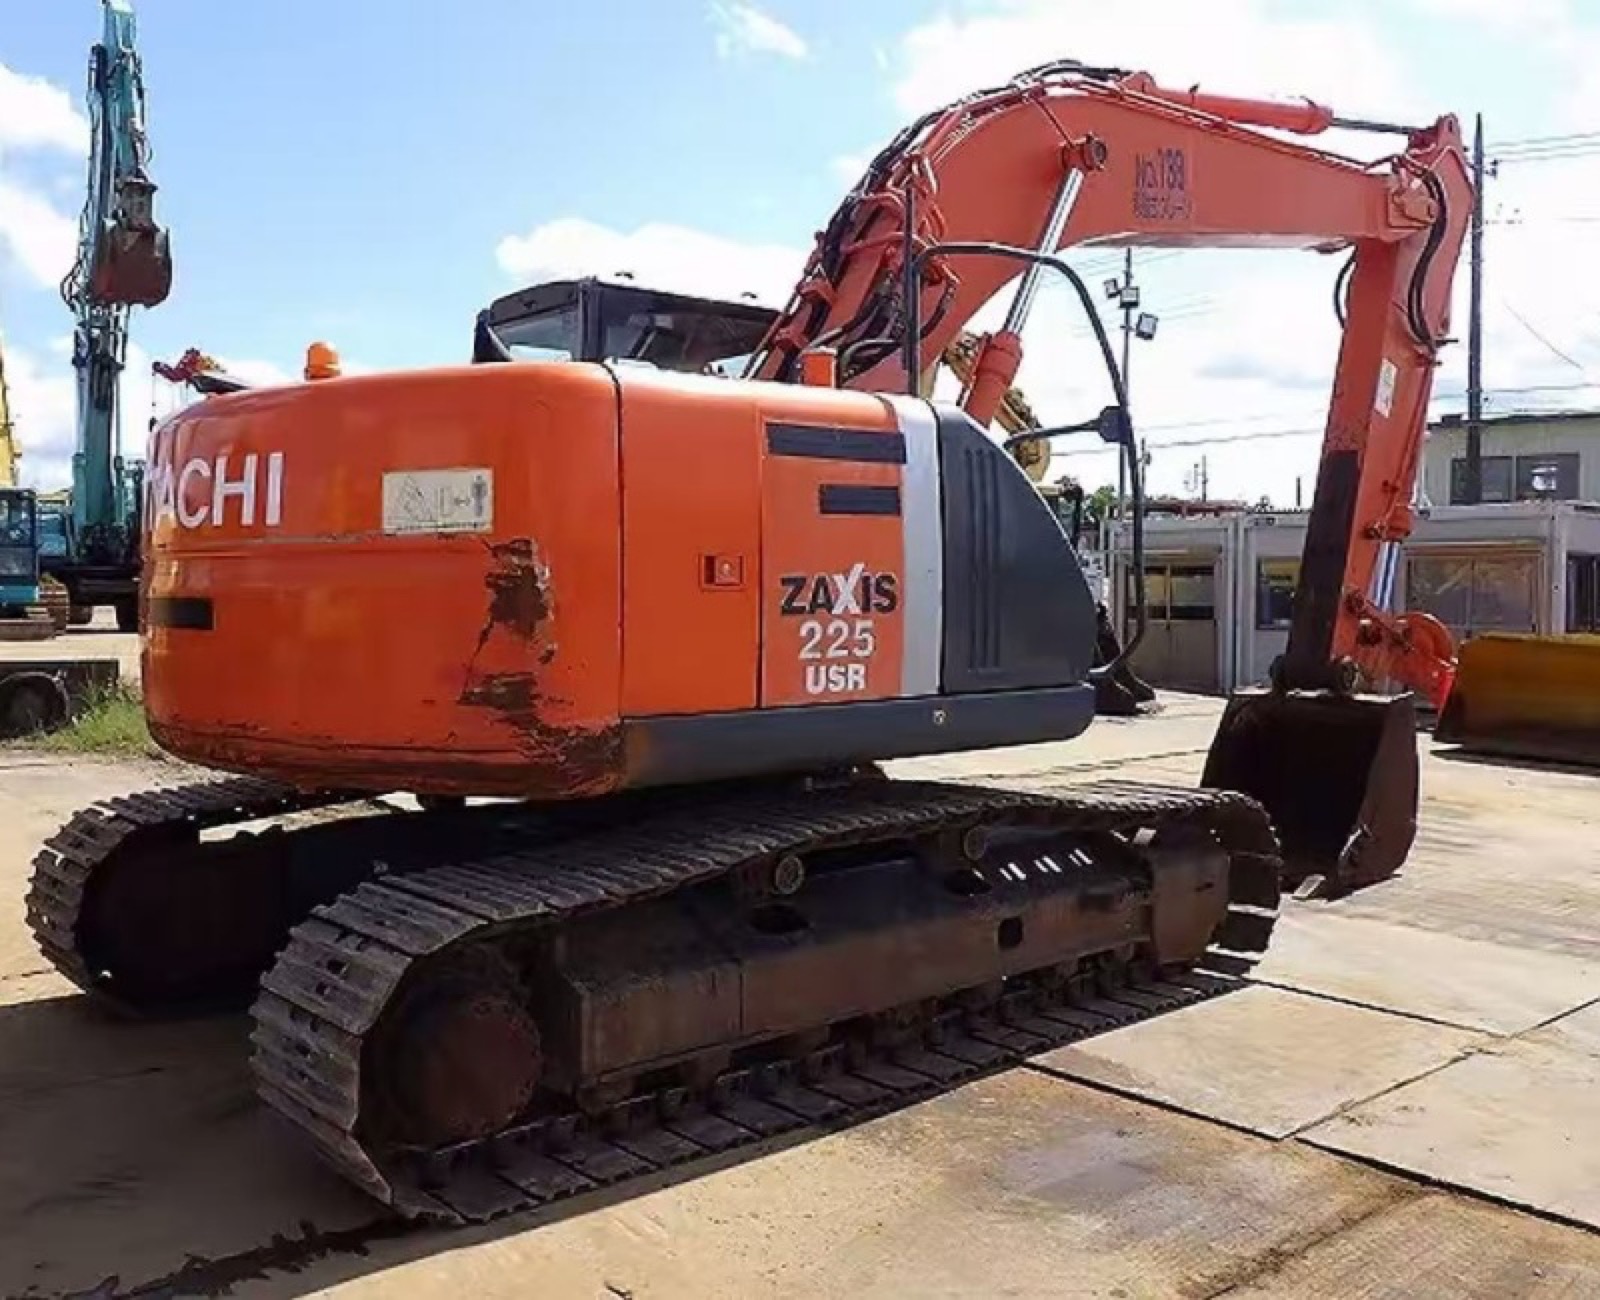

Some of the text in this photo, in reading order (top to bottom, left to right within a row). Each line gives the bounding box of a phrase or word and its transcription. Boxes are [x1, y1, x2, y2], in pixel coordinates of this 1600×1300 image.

[780, 562, 897, 616] ZAXIS
[799, 619, 875, 660] 225
[805, 663, 867, 694] USR
